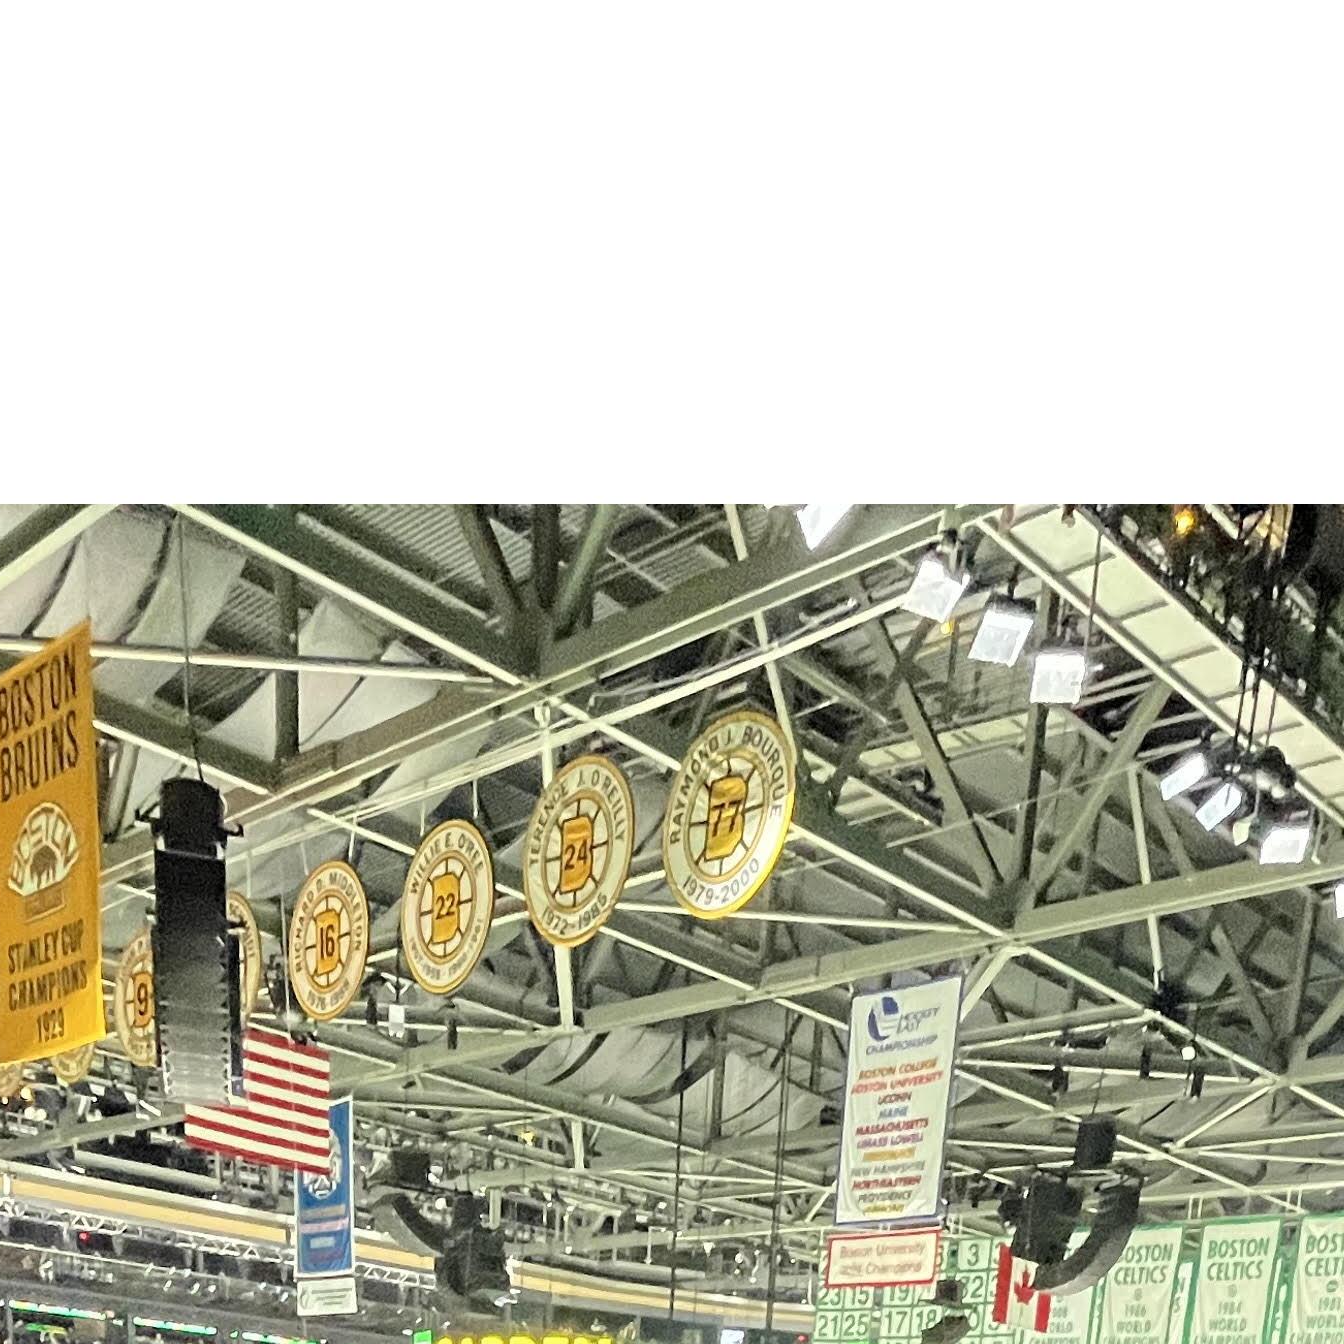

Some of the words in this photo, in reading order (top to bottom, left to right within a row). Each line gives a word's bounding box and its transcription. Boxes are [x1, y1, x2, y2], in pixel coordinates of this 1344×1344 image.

[1, 710, 78, 802] BRUINS
[669, 738, 718, 845] RAYMOND
[742, 726, 785, 818] BOURQUE
[529, 779, 570, 865] TERENCE
[711, 799, 743, 837] 77
[410, 840, 441, 895] WILLIE
[564, 840, 587, 870] 24
[682, 858, 760, 905] 1979-2000
[436, 893, 455, 920] 22
[9, 928, 56, 975] STANLEY
[61, 919, 84, 956] CUP
[320, 924, 335, 960] 16
[9, 960, 87, 1011] CHAMPIONS
[137, 982, 148, 1016] 9
[37, 1007, 64, 1043] 1929
[967, 1243, 979, 1266] 3
[1207, 1238, 1270, 1258] BOSTON
[1114, 1265, 1167, 1285] CELTICS
[1207, 1260, 1263, 1282] CELTICS
[819, 1315, 838, 1336] 21
[844, 1314, 868, 1336] 25
[885, 1311, 907, 1334] 17
[1117, 1321, 1152, 1334] WORLD
[1209, 1319, 1247, 1333] WORLD
